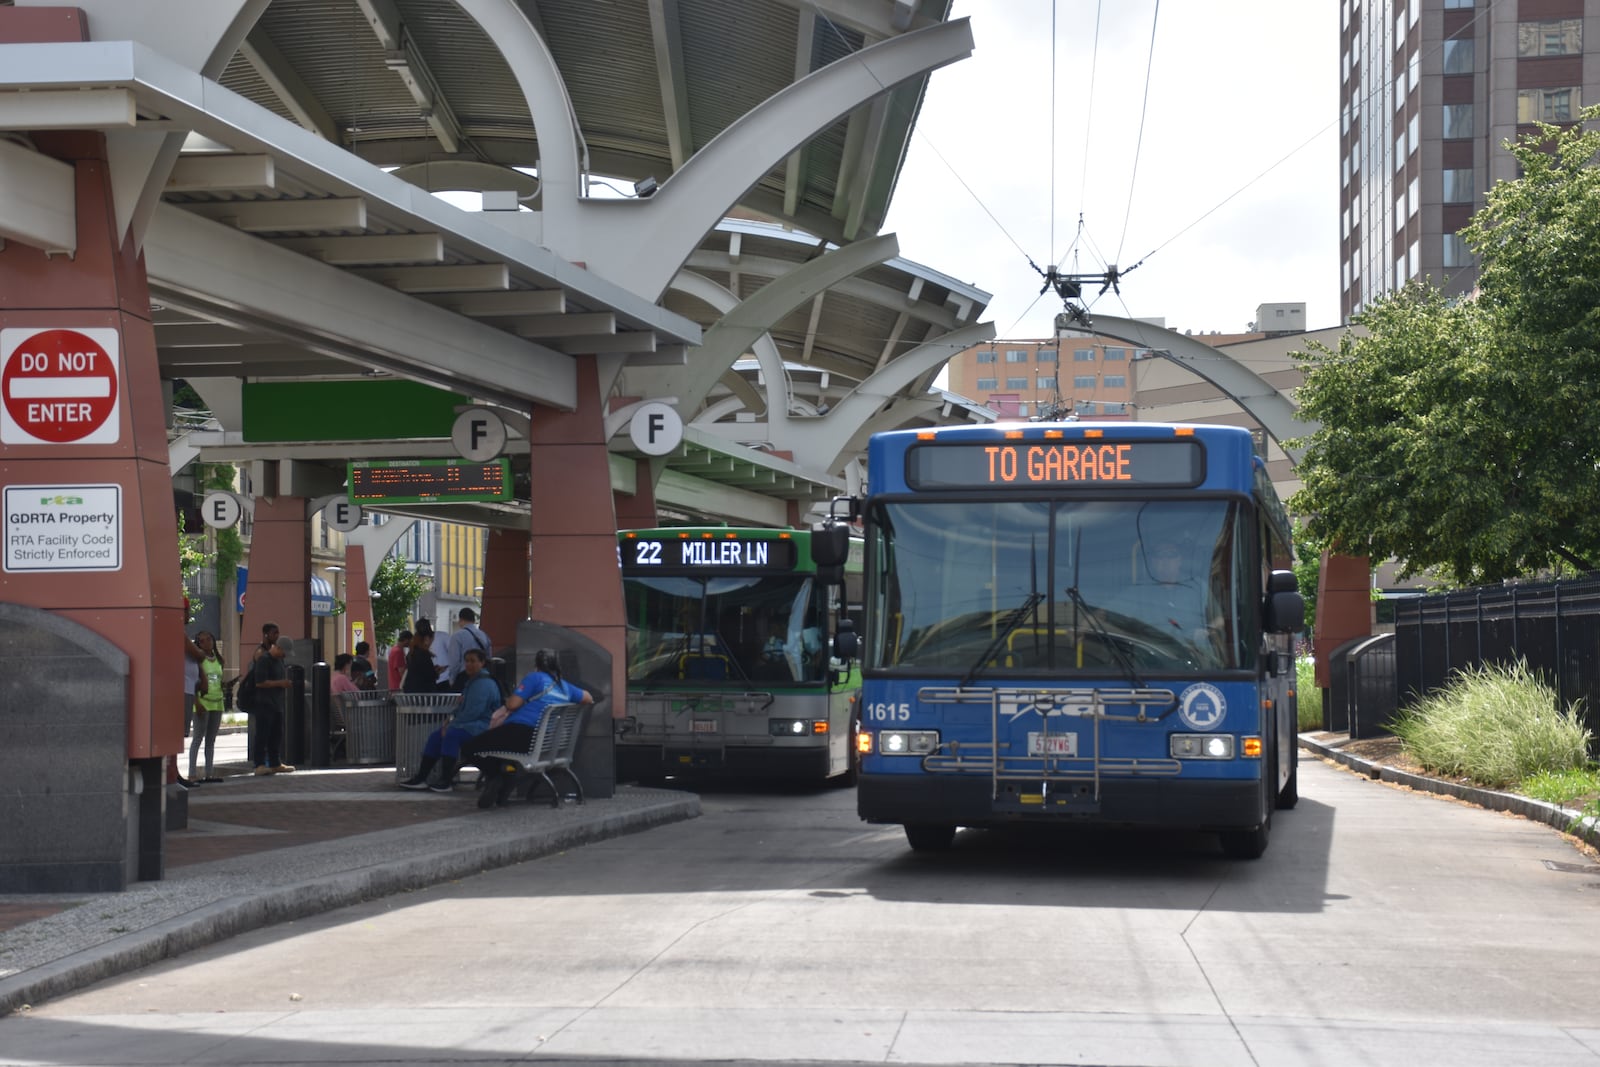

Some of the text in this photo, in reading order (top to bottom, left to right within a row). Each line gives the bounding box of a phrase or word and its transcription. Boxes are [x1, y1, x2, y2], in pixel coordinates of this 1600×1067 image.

[21, 352, 98, 372] DO NOT
[28, 403, 92, 422] ENTER
[471, 420, 487, 450] F
[648, 414, 664, 443] F
[984, 445, 1132, 482] TO GARAGE
[10, 512, 115, 525] GDRTA Property
[213, 500, 226, 521] E
[336, 503, 349, 524] E
[10, 534, 114, 548] RTA Facility Code
[14, 548, 111, 562] Strictly Enforced
[636, 541, 768, 565] 22 MILLER LN
[867, 702, 911, 721] 1615
